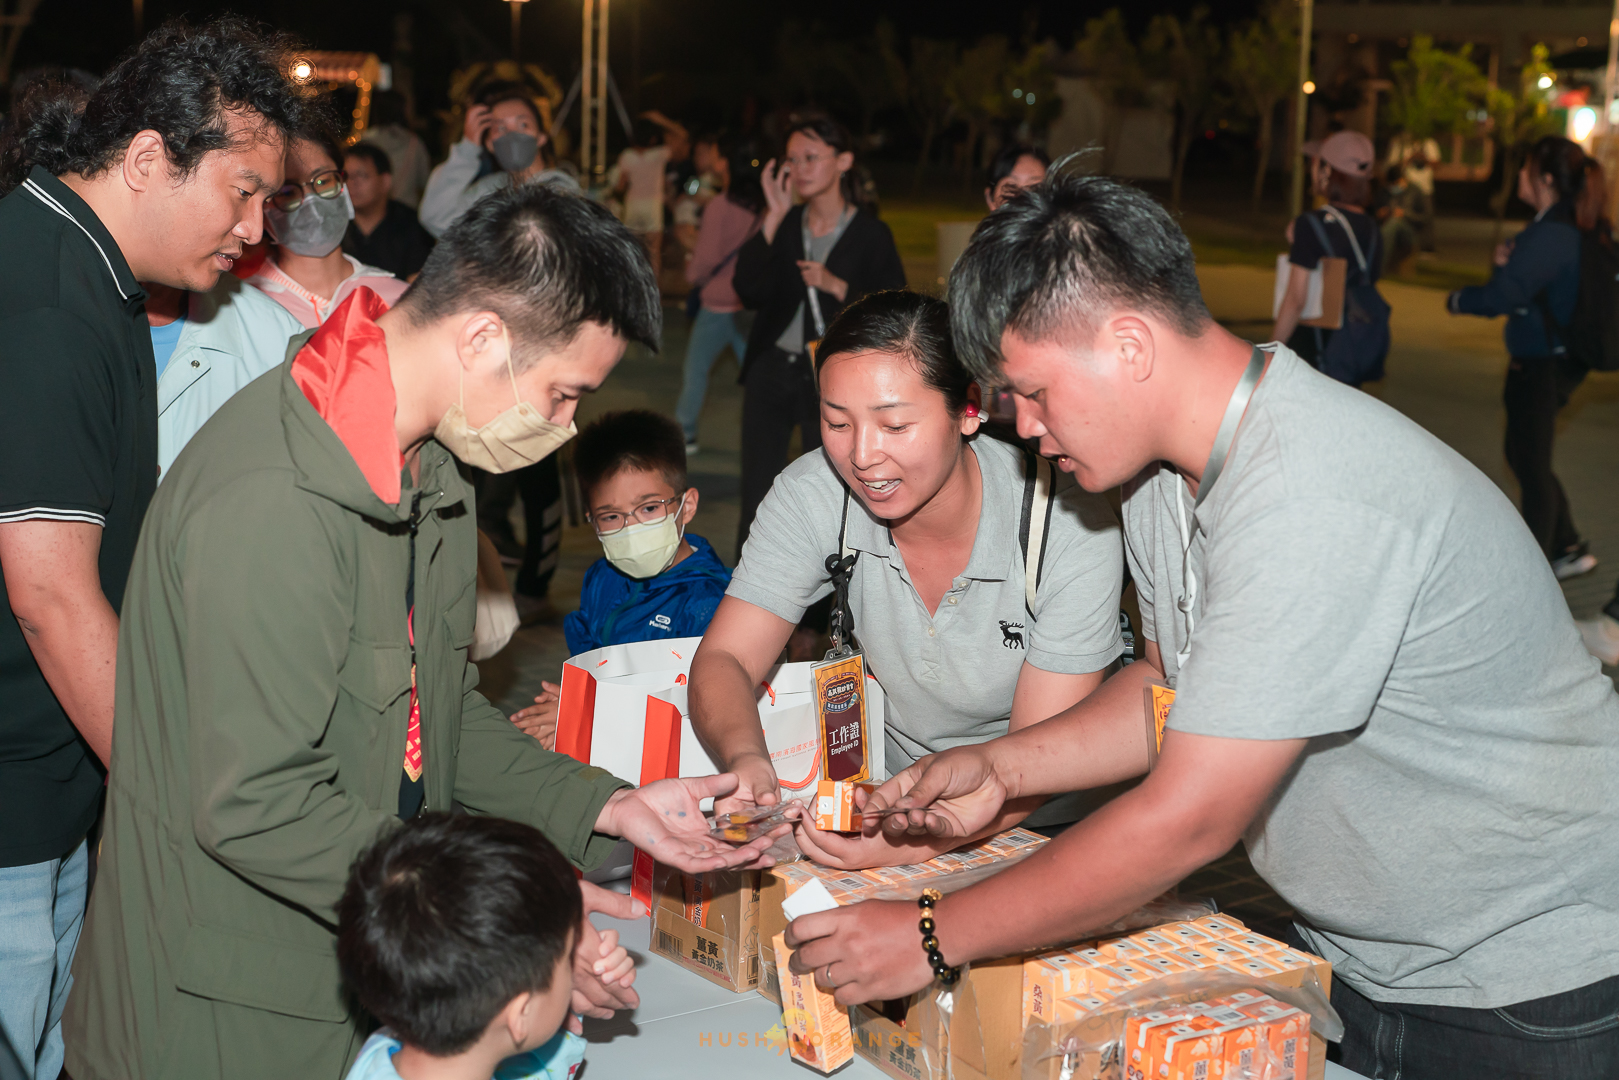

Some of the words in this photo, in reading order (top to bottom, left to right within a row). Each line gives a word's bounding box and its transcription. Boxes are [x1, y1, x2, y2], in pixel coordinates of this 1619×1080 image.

[829, 721, 860, 747] 工作證
[831, 743, 854, 756] Employee
[853, 739, 859, 748] ID
[696, 935, 719, 959] 薑黃
[691, 948, 724, 973] 黃金奶茶
